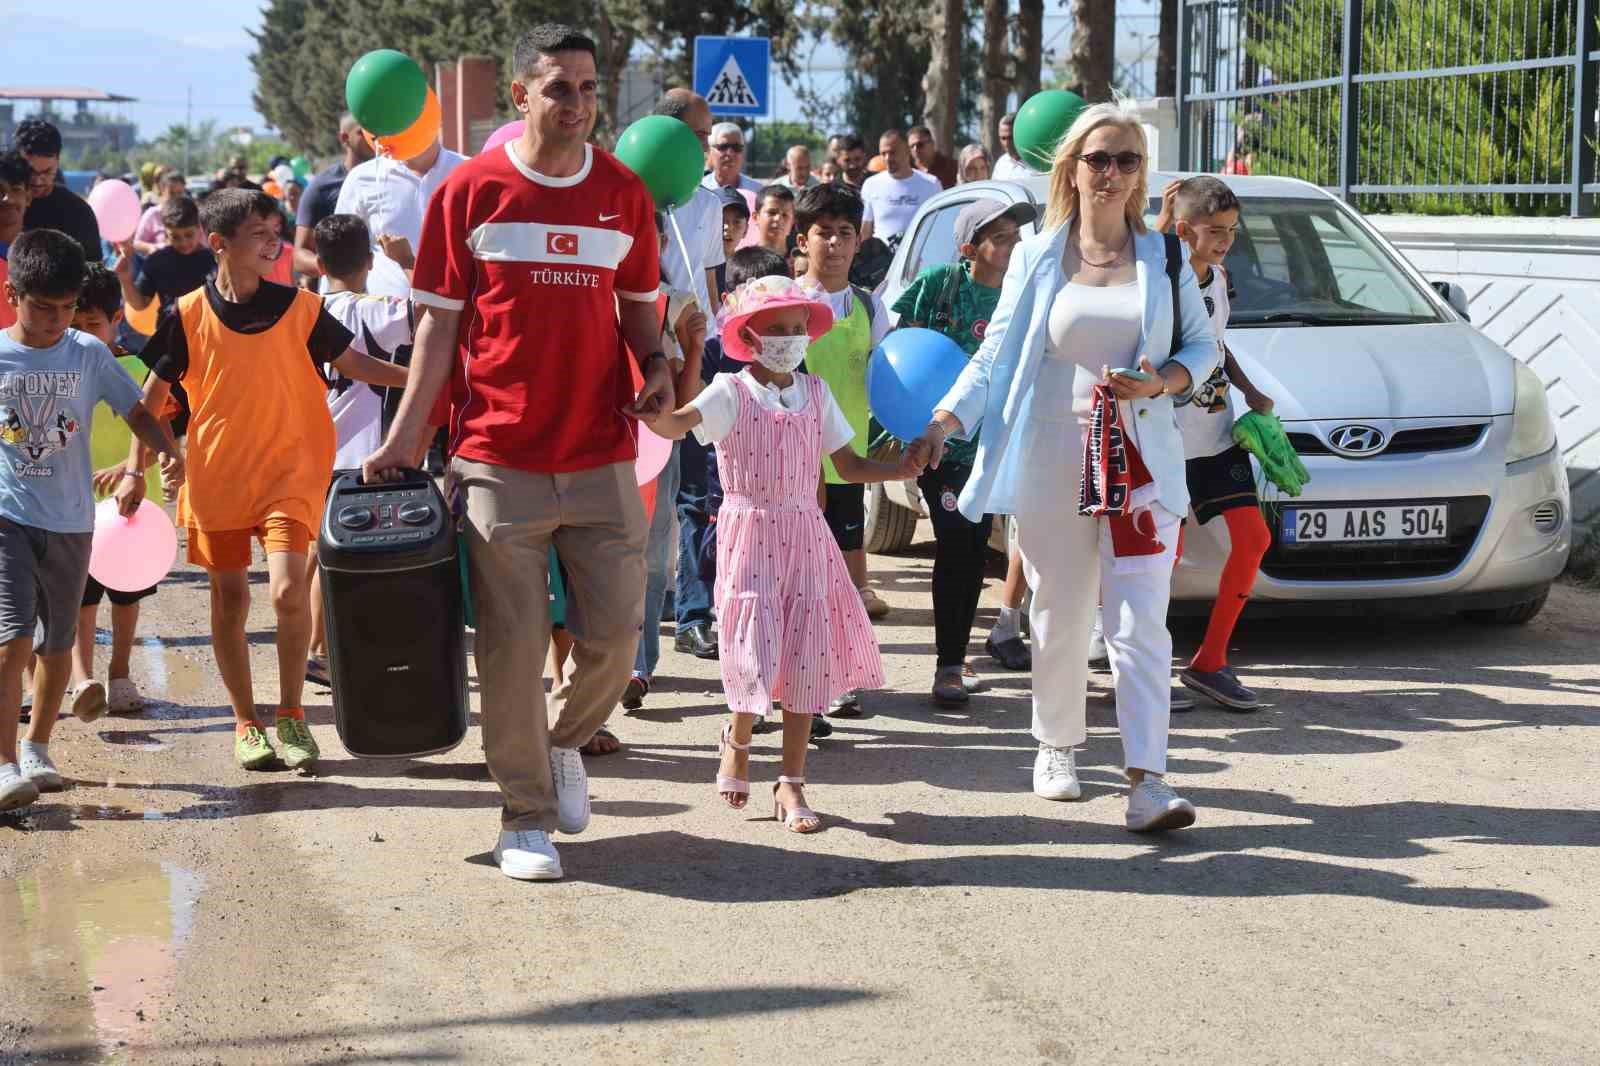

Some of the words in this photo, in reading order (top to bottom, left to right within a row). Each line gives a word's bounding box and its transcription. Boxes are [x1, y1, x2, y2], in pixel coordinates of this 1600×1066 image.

[530, 268, 600, 289] TÜRKİYE
[1299, 511, 1328, 539] 29
[1343, 510, 1386, 538] AAS
[1401, 508, 1445, 536] 504
